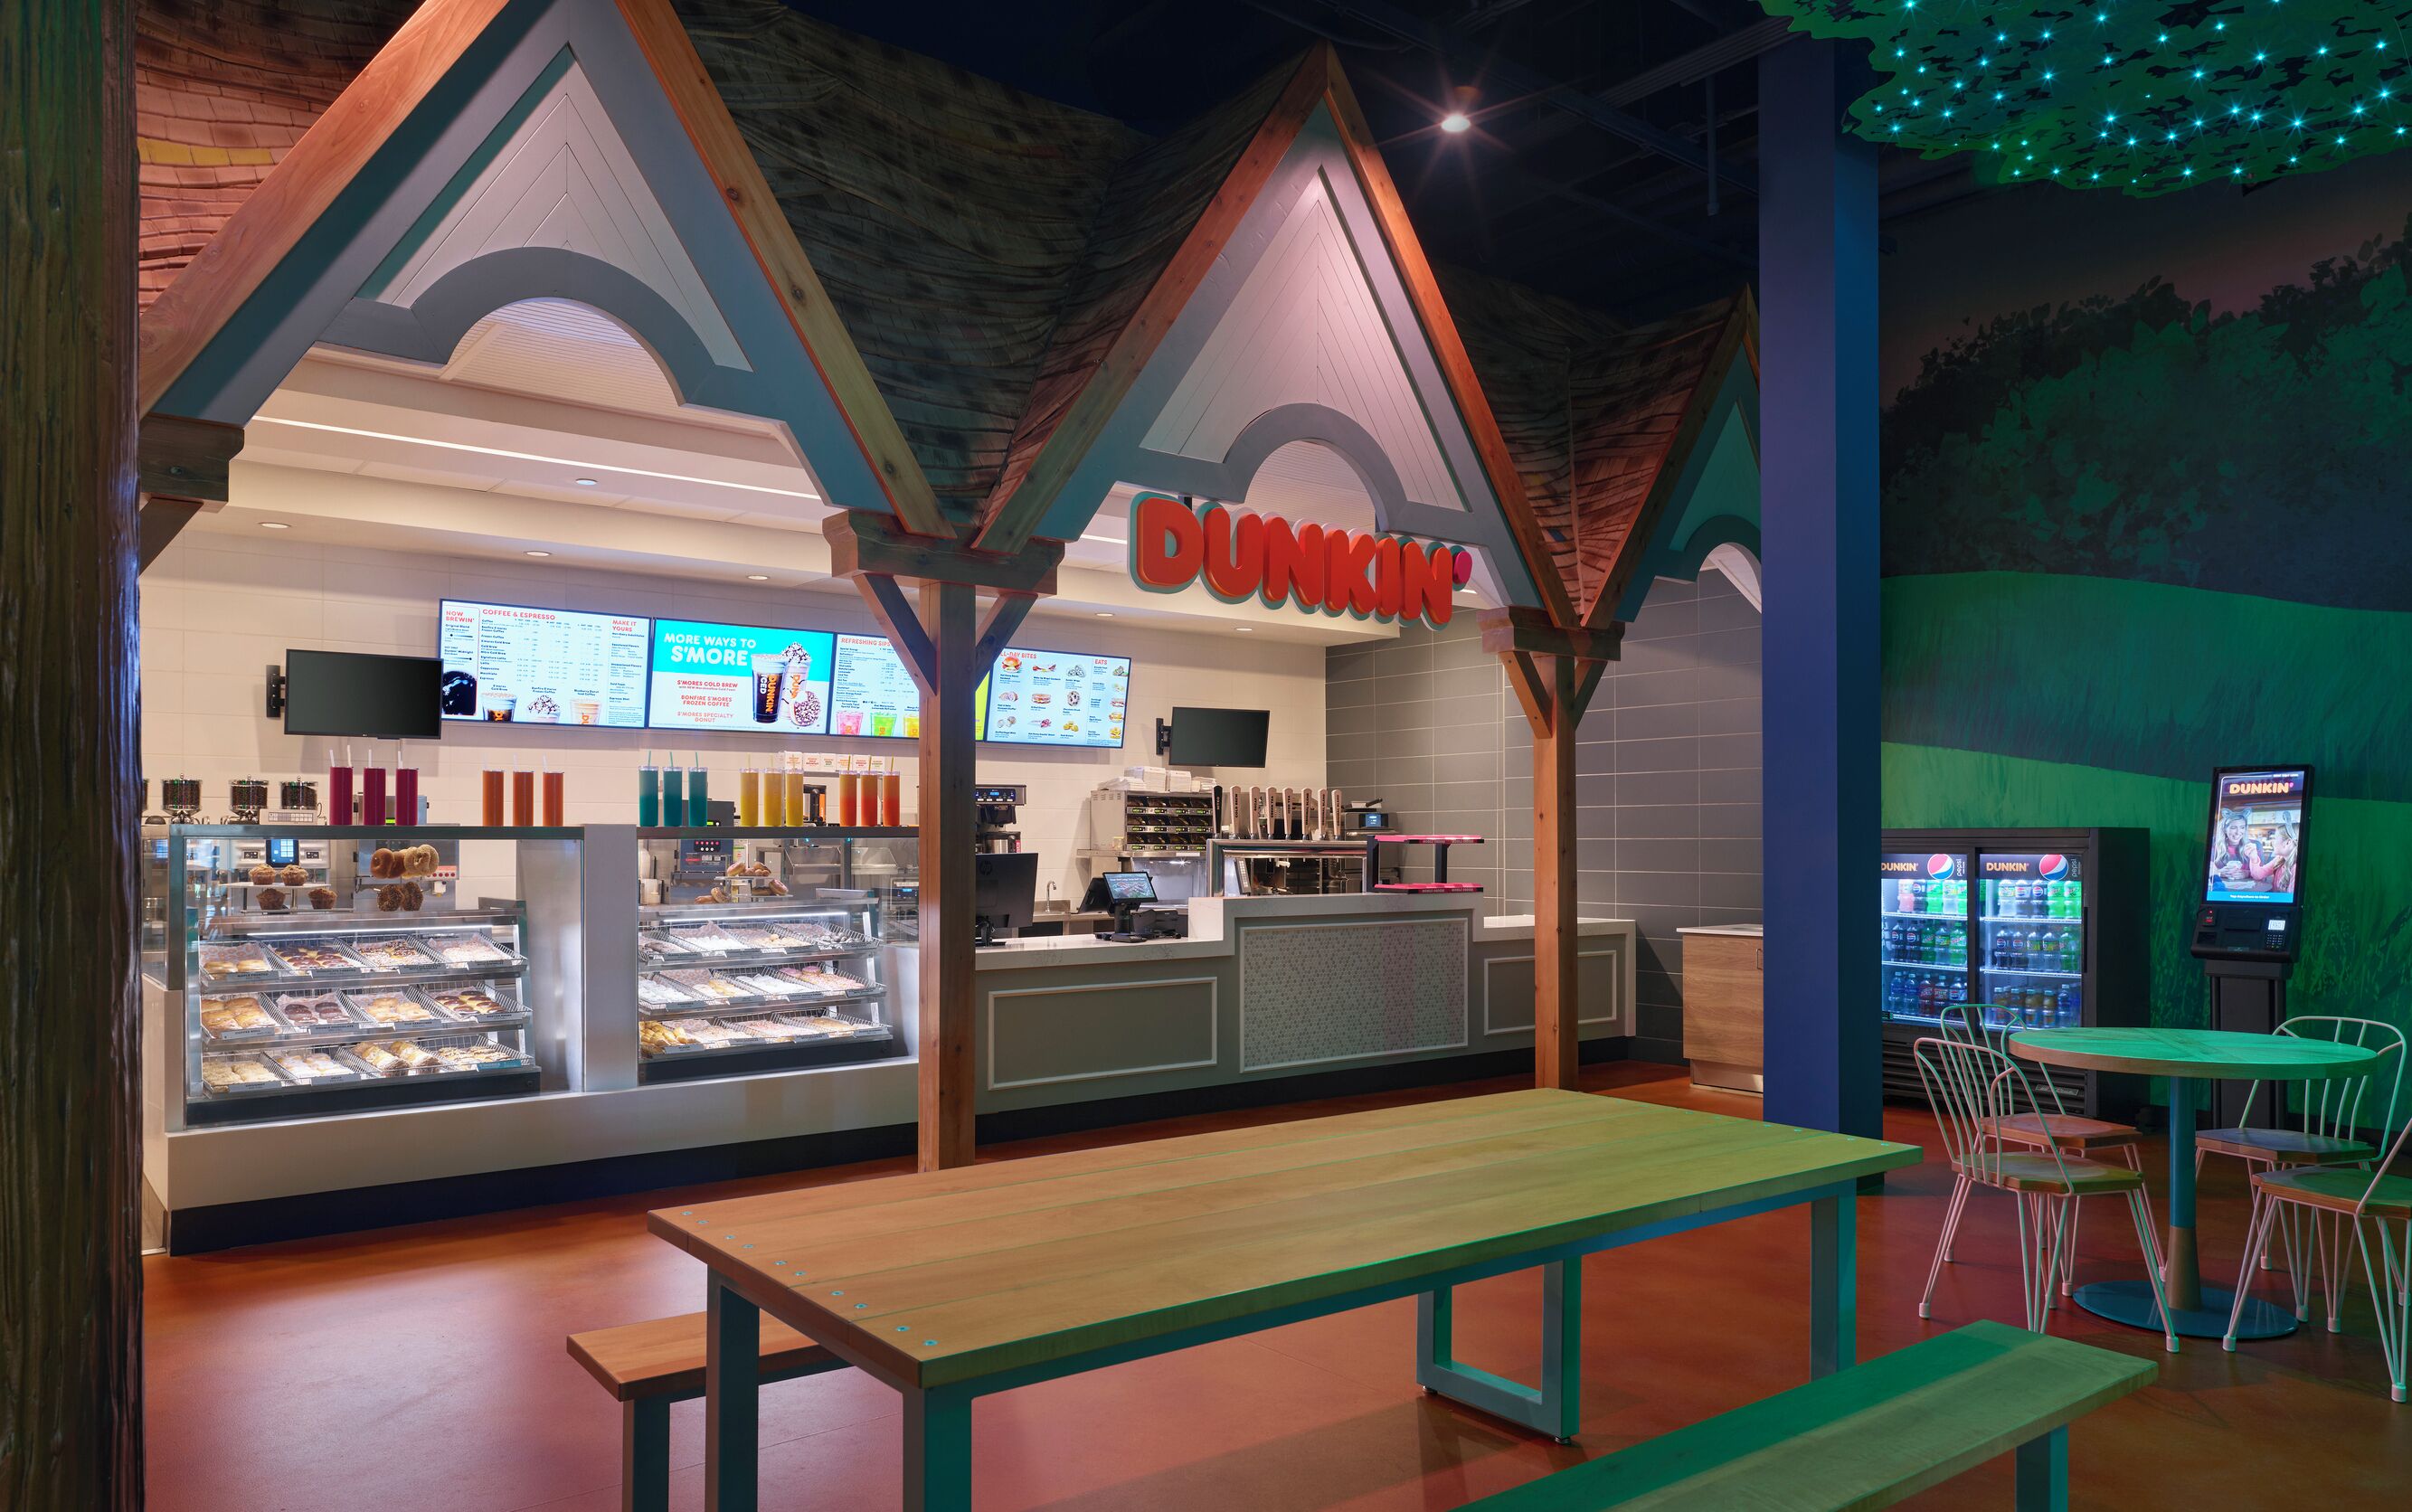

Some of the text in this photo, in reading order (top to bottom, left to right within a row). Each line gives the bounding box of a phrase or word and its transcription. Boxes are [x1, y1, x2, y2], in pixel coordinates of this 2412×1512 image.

[1129, 492, 1473, 630] DUNKIN'
[483, 609, 511, 617] COFFEE
[520, 612, 555, 621] ESPRESSO
[664, 632, 757, 648] MORE WAYS TO
[840, 638, 877, 646] REFRESHING
[671, 645, 749, 666] S'MORE
[760, 674, 768, 695] ICED
[2229, 782, 2294, 795] DUNKIN'
[1881, 862, 1919, 872] DUNKIN'
[1986, 862, 2029, 872] DUNKIN'
[2070, 858, 2078, 877] pepsi
